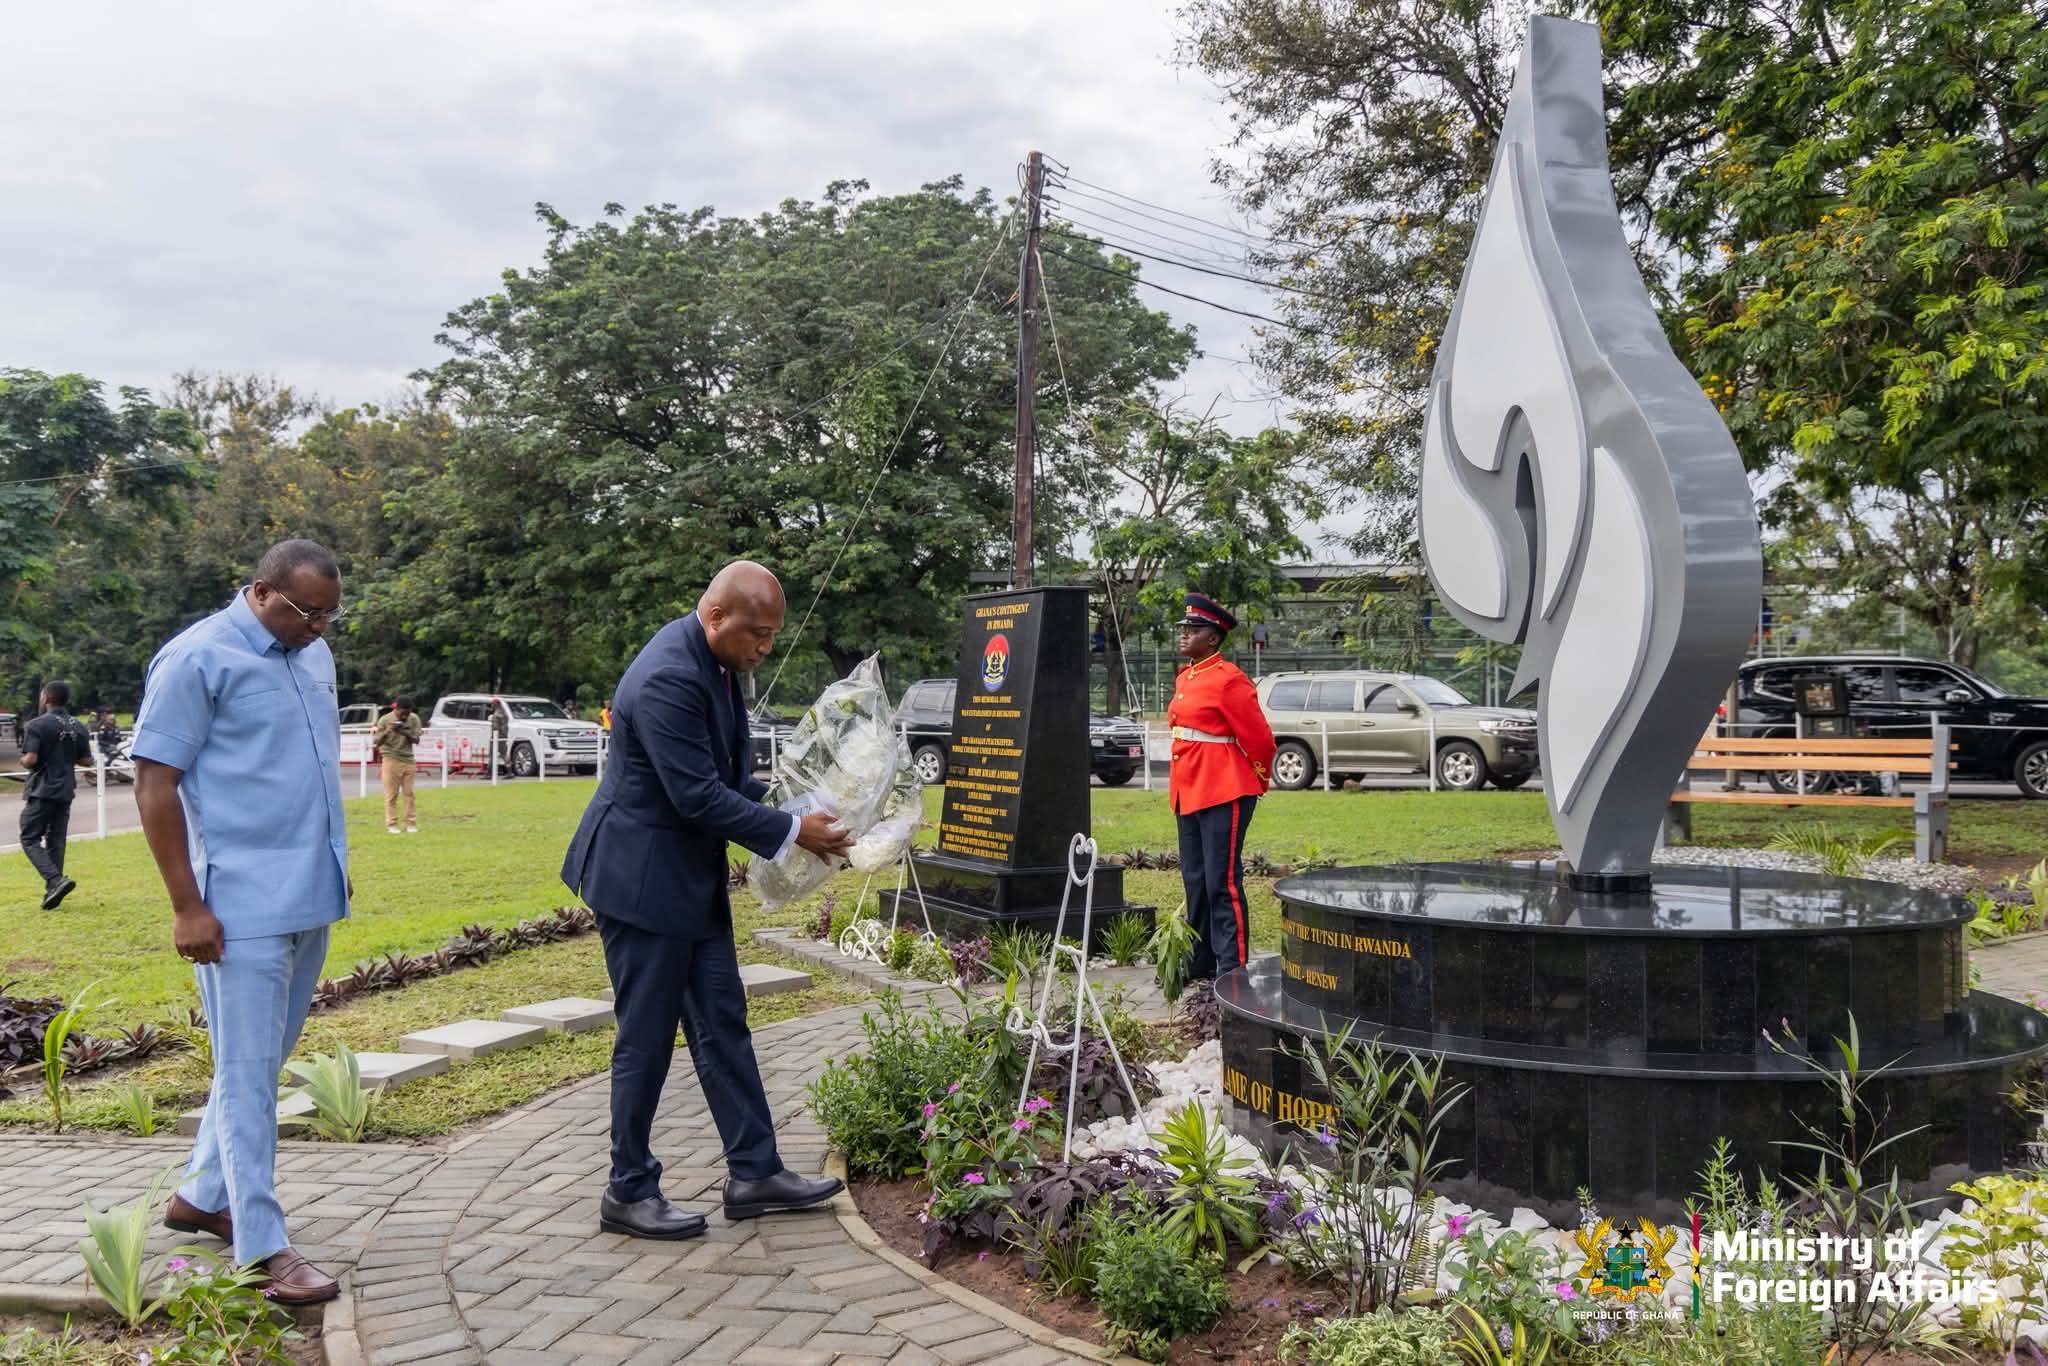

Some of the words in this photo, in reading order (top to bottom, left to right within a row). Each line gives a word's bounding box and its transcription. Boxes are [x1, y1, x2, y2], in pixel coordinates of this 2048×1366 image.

[1296, 923, 1310, 941] THE
[1310, 927, 1338, 949] TUTSI
[1340, 932, 1353, 950] IN
[1354, 936, 1412, 959] RWANDA
[1306, 968, 1339, 991] RENEW
[1251, 1080, 1273, 1114] OF
